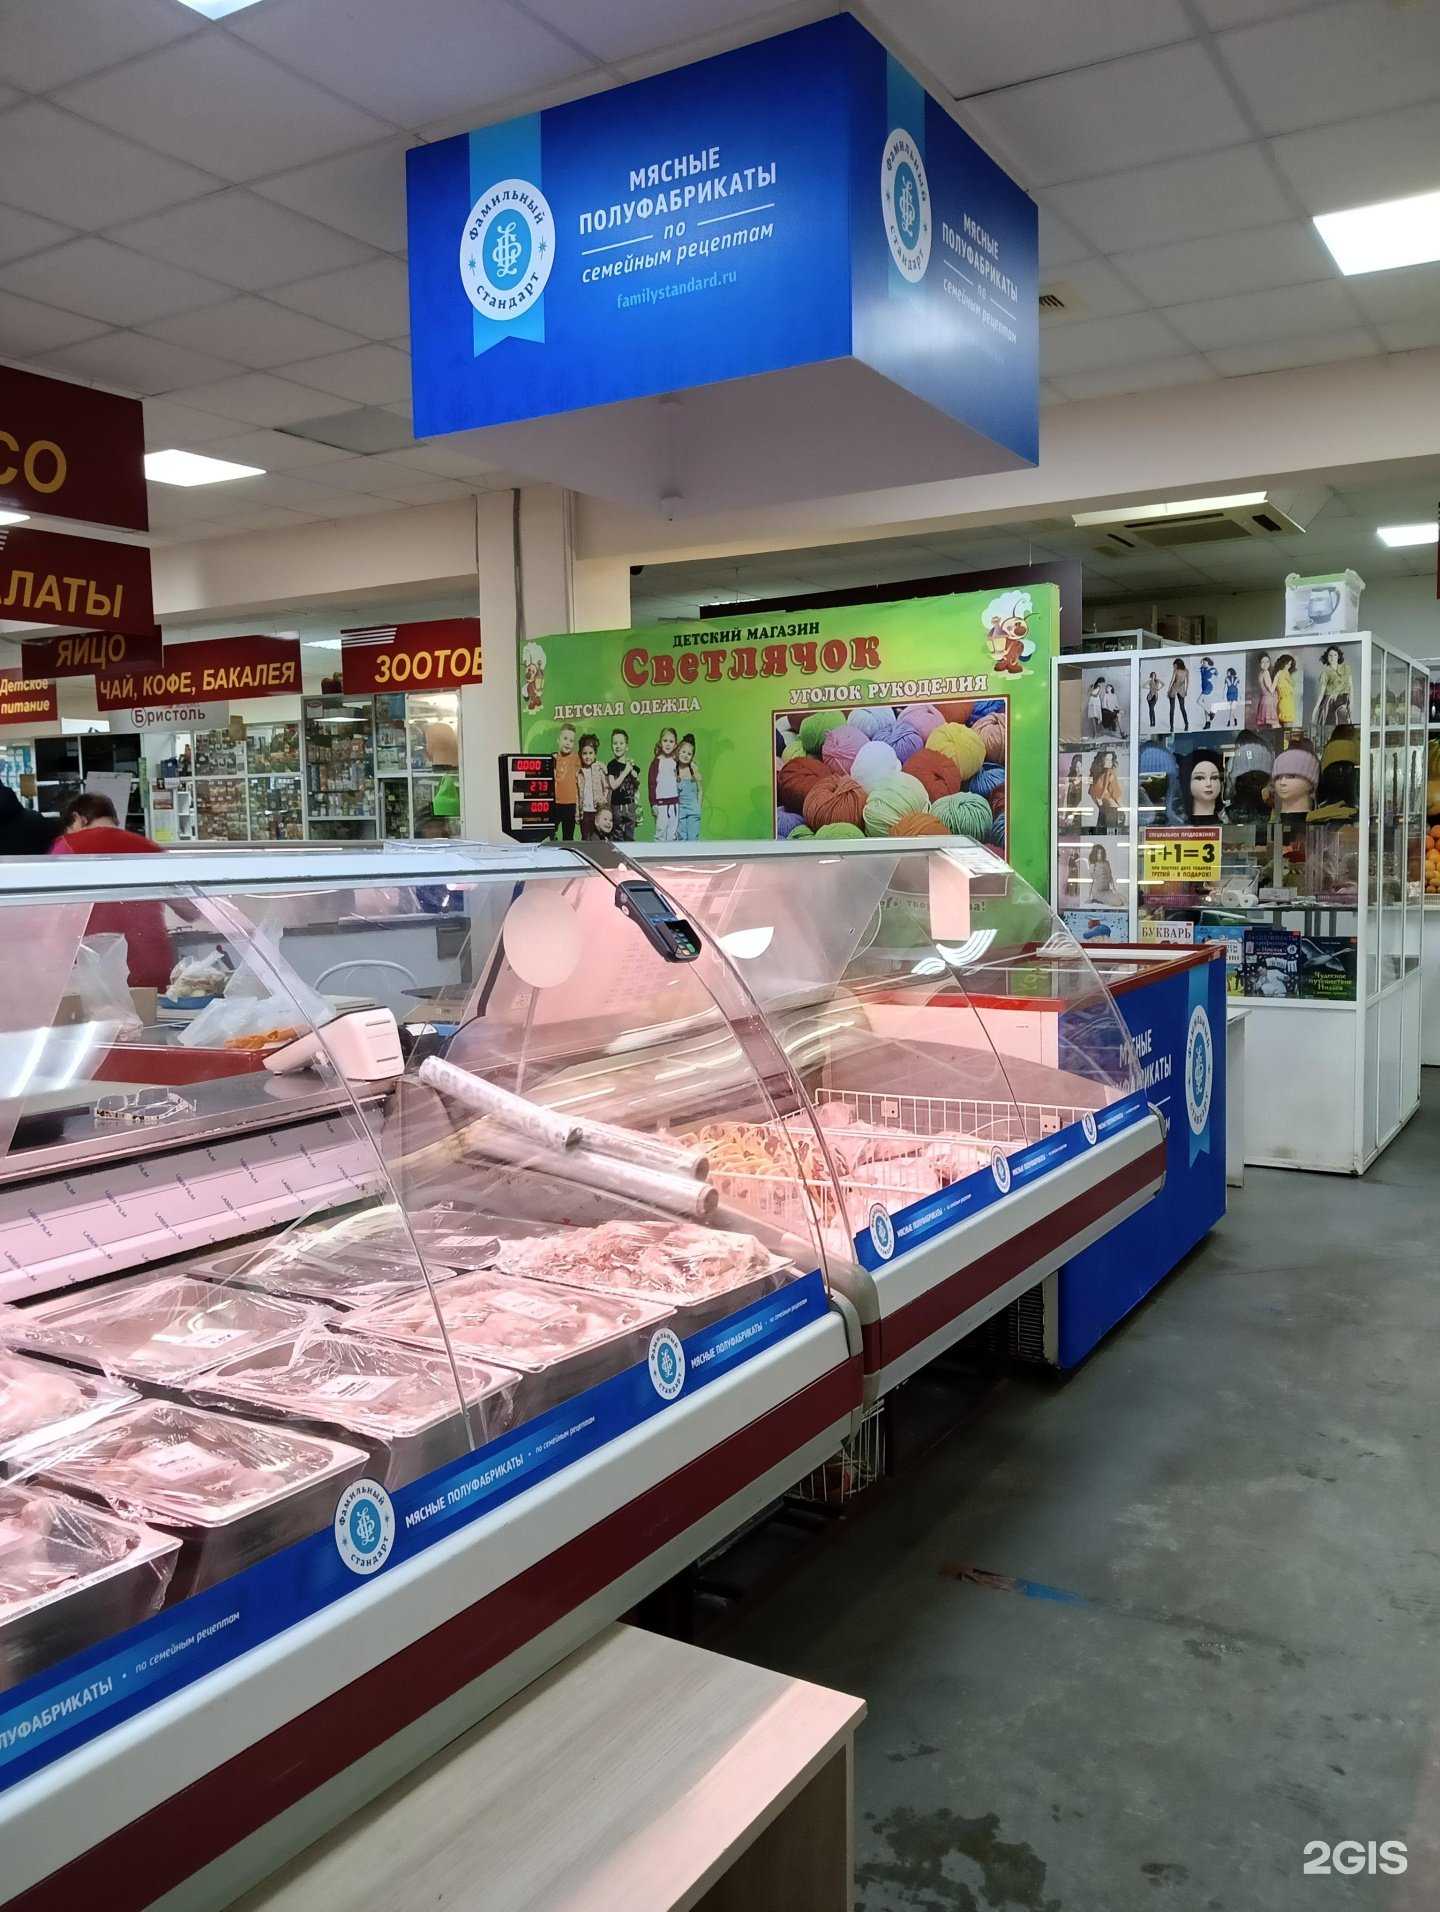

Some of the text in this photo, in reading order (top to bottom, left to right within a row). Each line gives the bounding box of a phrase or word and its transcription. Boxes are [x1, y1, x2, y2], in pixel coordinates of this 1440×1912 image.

[629, 146, 720, 192] МЯСНЫЕ
[469, 190, 544, 241] Фамильный
[579, 162, 776, 235] ПОЛУФАБРИКАТЫ
[664, 221, 686, 239] по
[963, 212, 1000, 260] МЯСНЫЕ
[582, 223, 774, 283] семейным рецептам
[942, 221, 1018, 302] ПОЛУФАБРИКАТЫ
[476, 271, 540, 310] стандарт
[617, 270, 737, 309] familystandard.ru
[0, 570, 123, 618] ЛАТЫ
[673, 621, 820, 648] ДЕТСКИЙ МАГАЗИН
[0, 679, 48, 696] Детское
[100, 661, 296, 701] ЧАЙ, КОФЕ, БАКАЛЕЯ
[789, 674, 988, 705] УГОЛОК РУКОДЕЛИЯ
[1, 700, 49, 714] питание
[132, 707, 206, 727] Бристоль
[554, 696, 701, 720] ДЕТСКАЯ ОДЕЖДА
[1142, 927, 1191, 938] БУКВАРЬ
[691, 1347, 716, 1369] МЯСНЫЕ
[716, 1323, 763, 1354] ПОЛУФАБРИКАТЫ
[339, 1487, 385, 1525] Фамильный
[405, 1495, 446, 1529] МЯСНЫЕ
[447, 1454, 523, 1505] ПОЛУФАБРИКАТЫ
[351, 1536, 389, 1566] стандарт
[135, 1663, 147, 1674] по
[149, 1636, 195, 1667] семейным
[197, 1611, 240, 1641] рецептам
